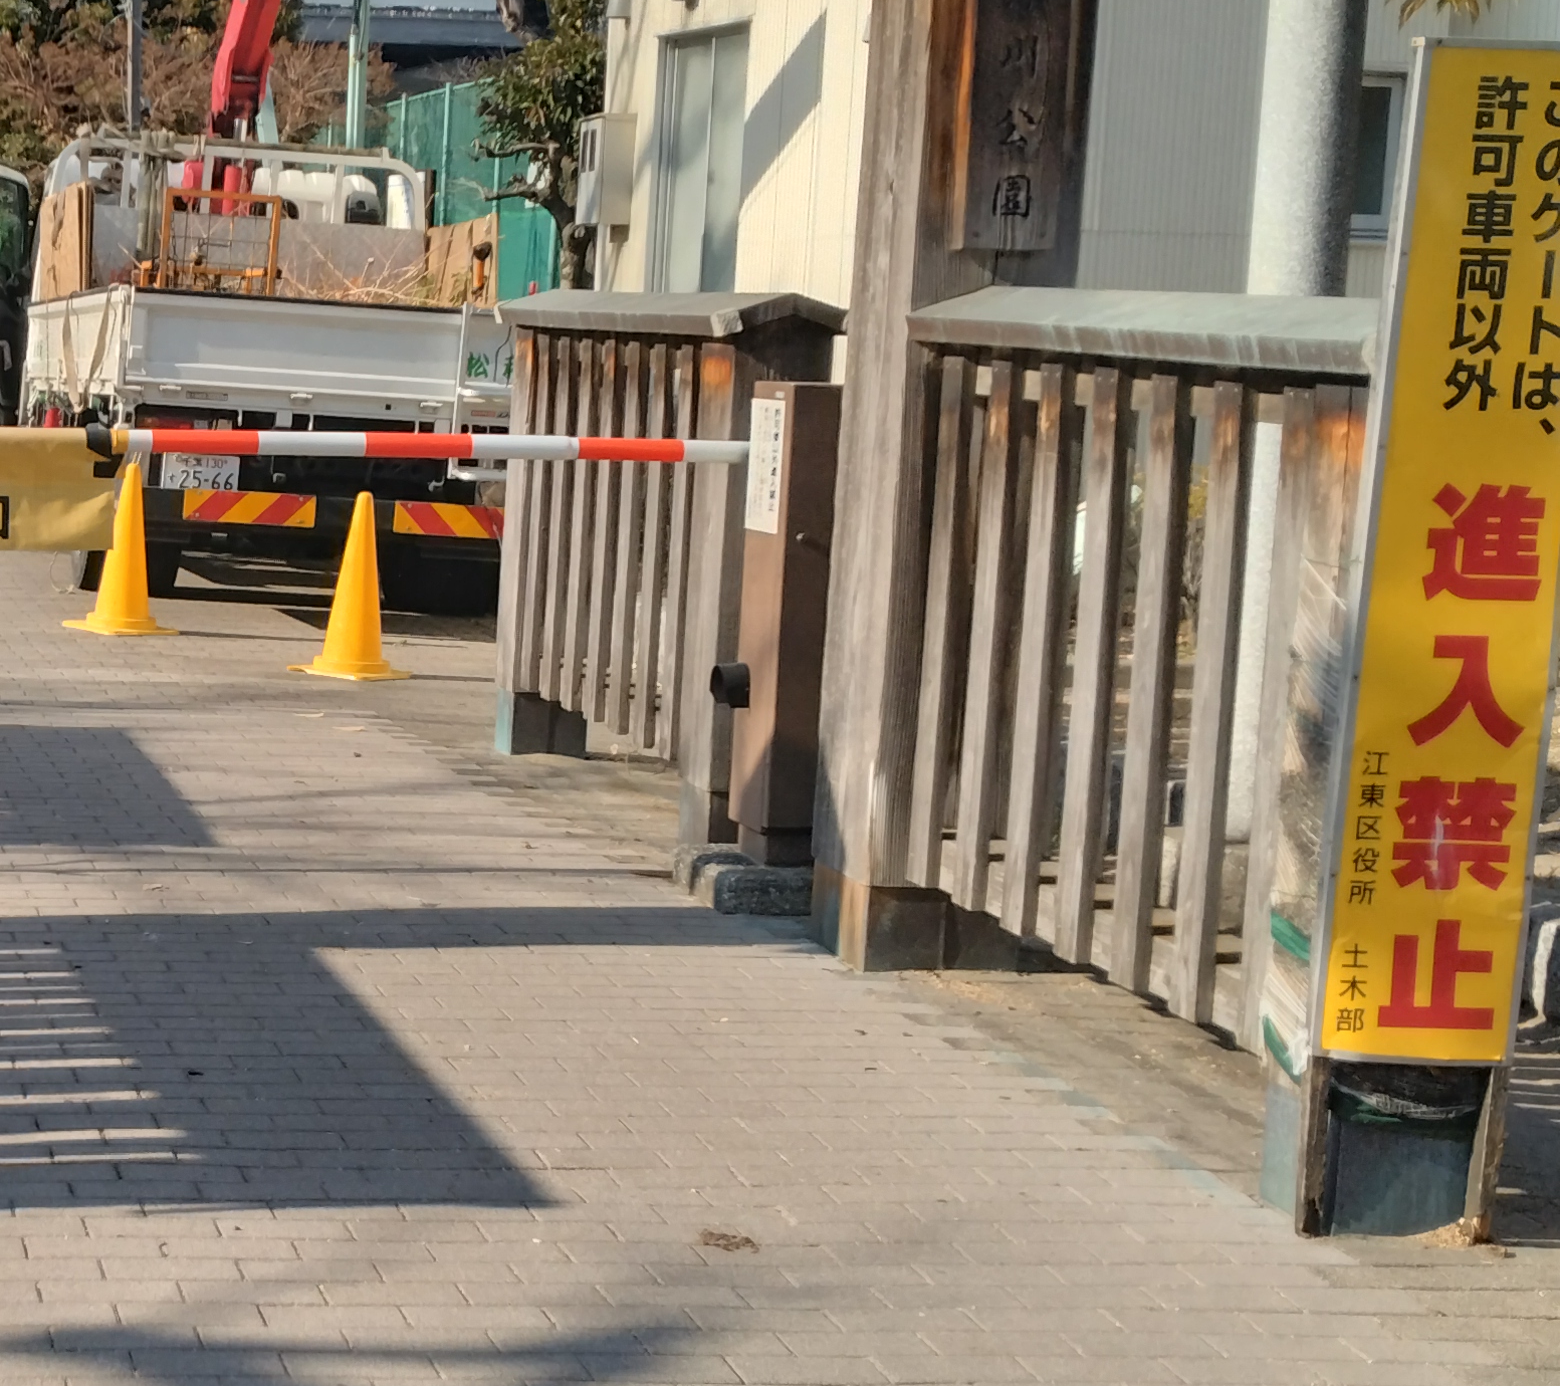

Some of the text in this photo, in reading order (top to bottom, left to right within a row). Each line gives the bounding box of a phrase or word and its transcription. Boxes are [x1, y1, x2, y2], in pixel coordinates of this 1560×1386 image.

[1443, 75, 1528, 412] 許可車両以外
[178, 470, 234, 490] 25-66
[1336, 751, 1390, 1033] 江東区役所 土木部
[1377, 482, 1545, 1031] 進入禁止
